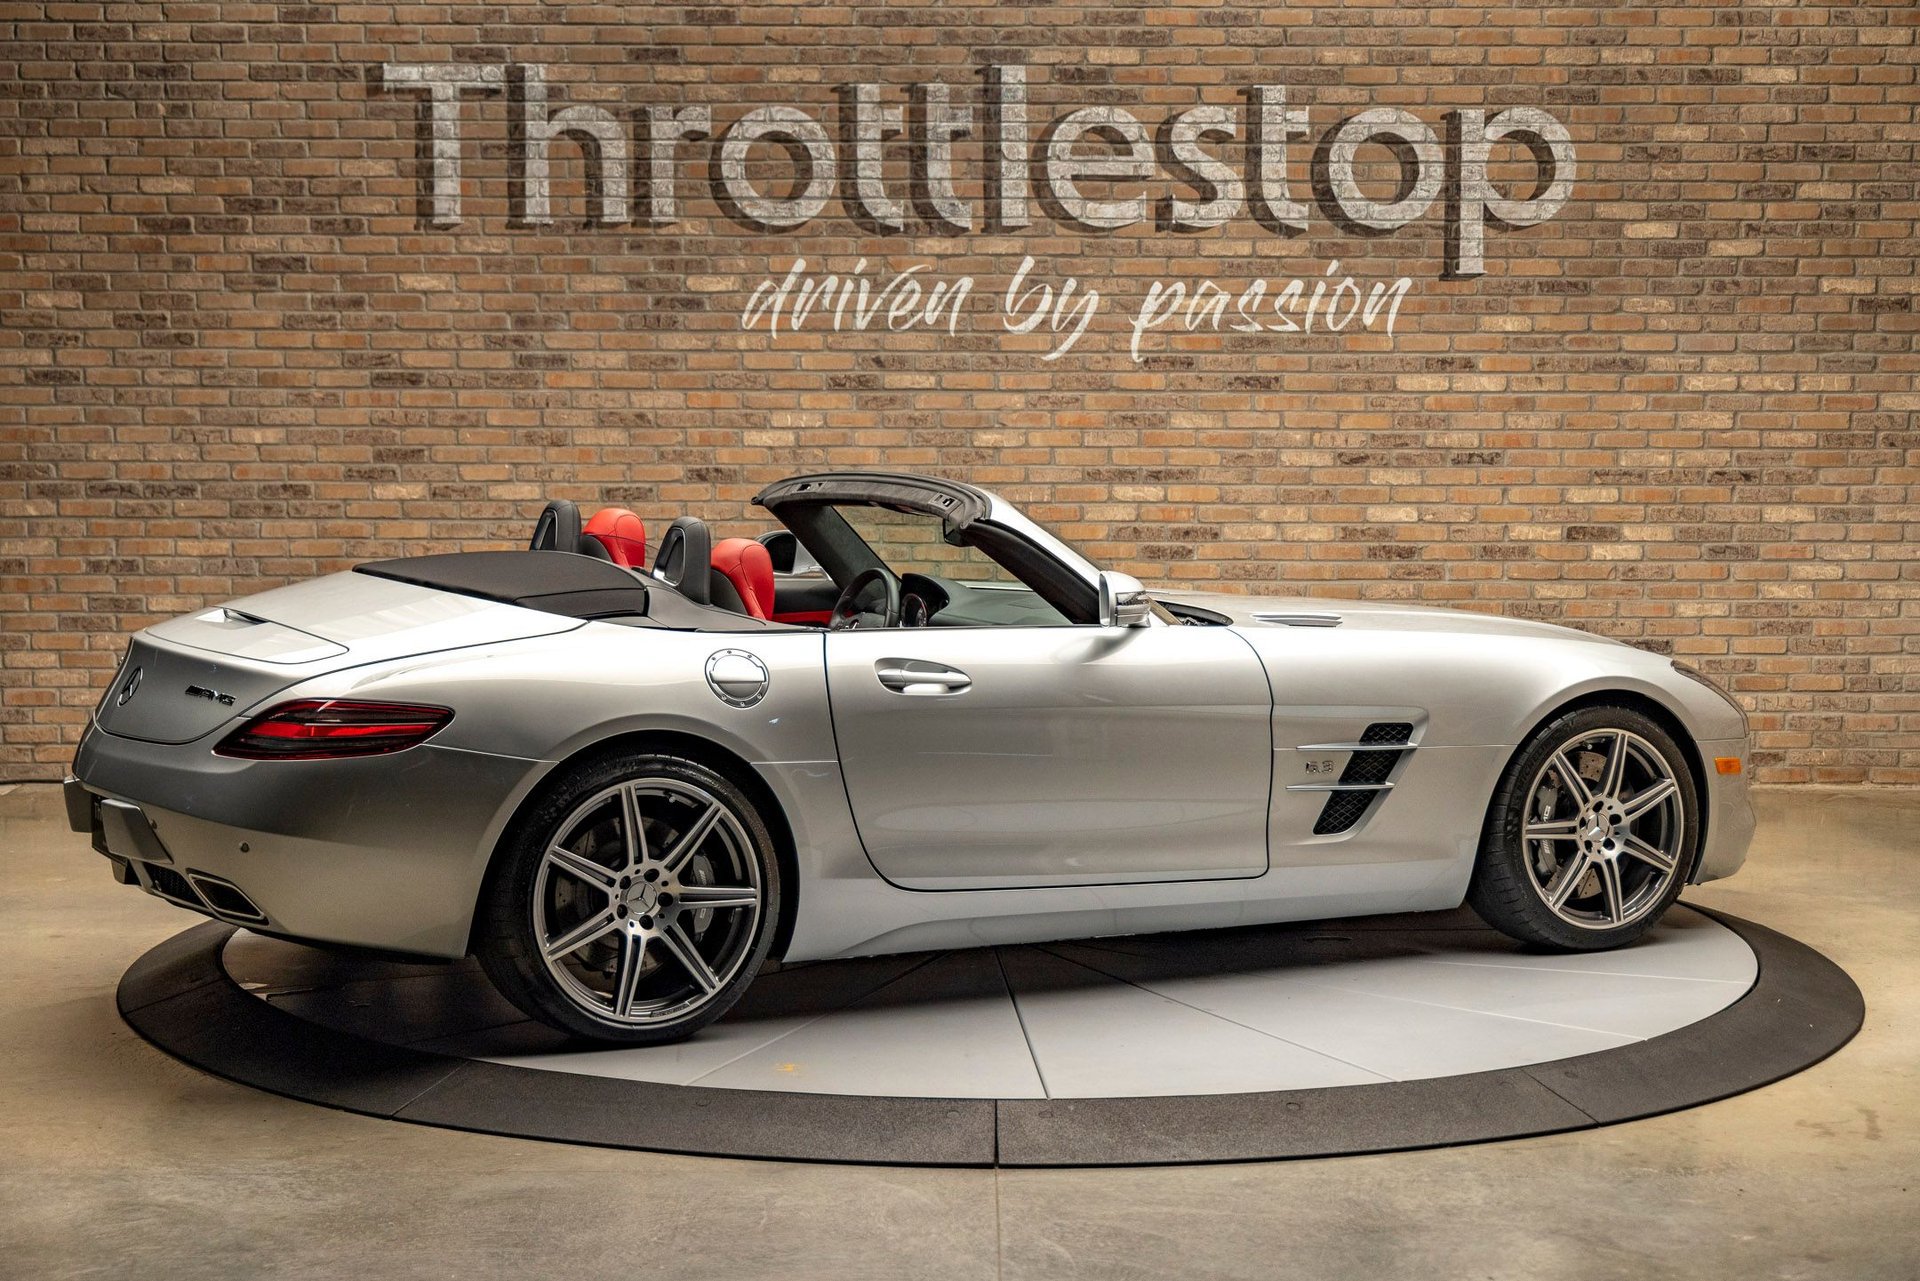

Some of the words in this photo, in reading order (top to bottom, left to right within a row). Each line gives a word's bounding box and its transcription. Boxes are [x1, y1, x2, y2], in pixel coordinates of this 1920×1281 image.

[383, 63, 1578, 275] Throttlestop
[741, 257, 975, 340] driven
[1002, 255, 1101, 362] by
[1128, 259, 1413, 363] passion
[1305, 760, 1334, 774] 6.3
